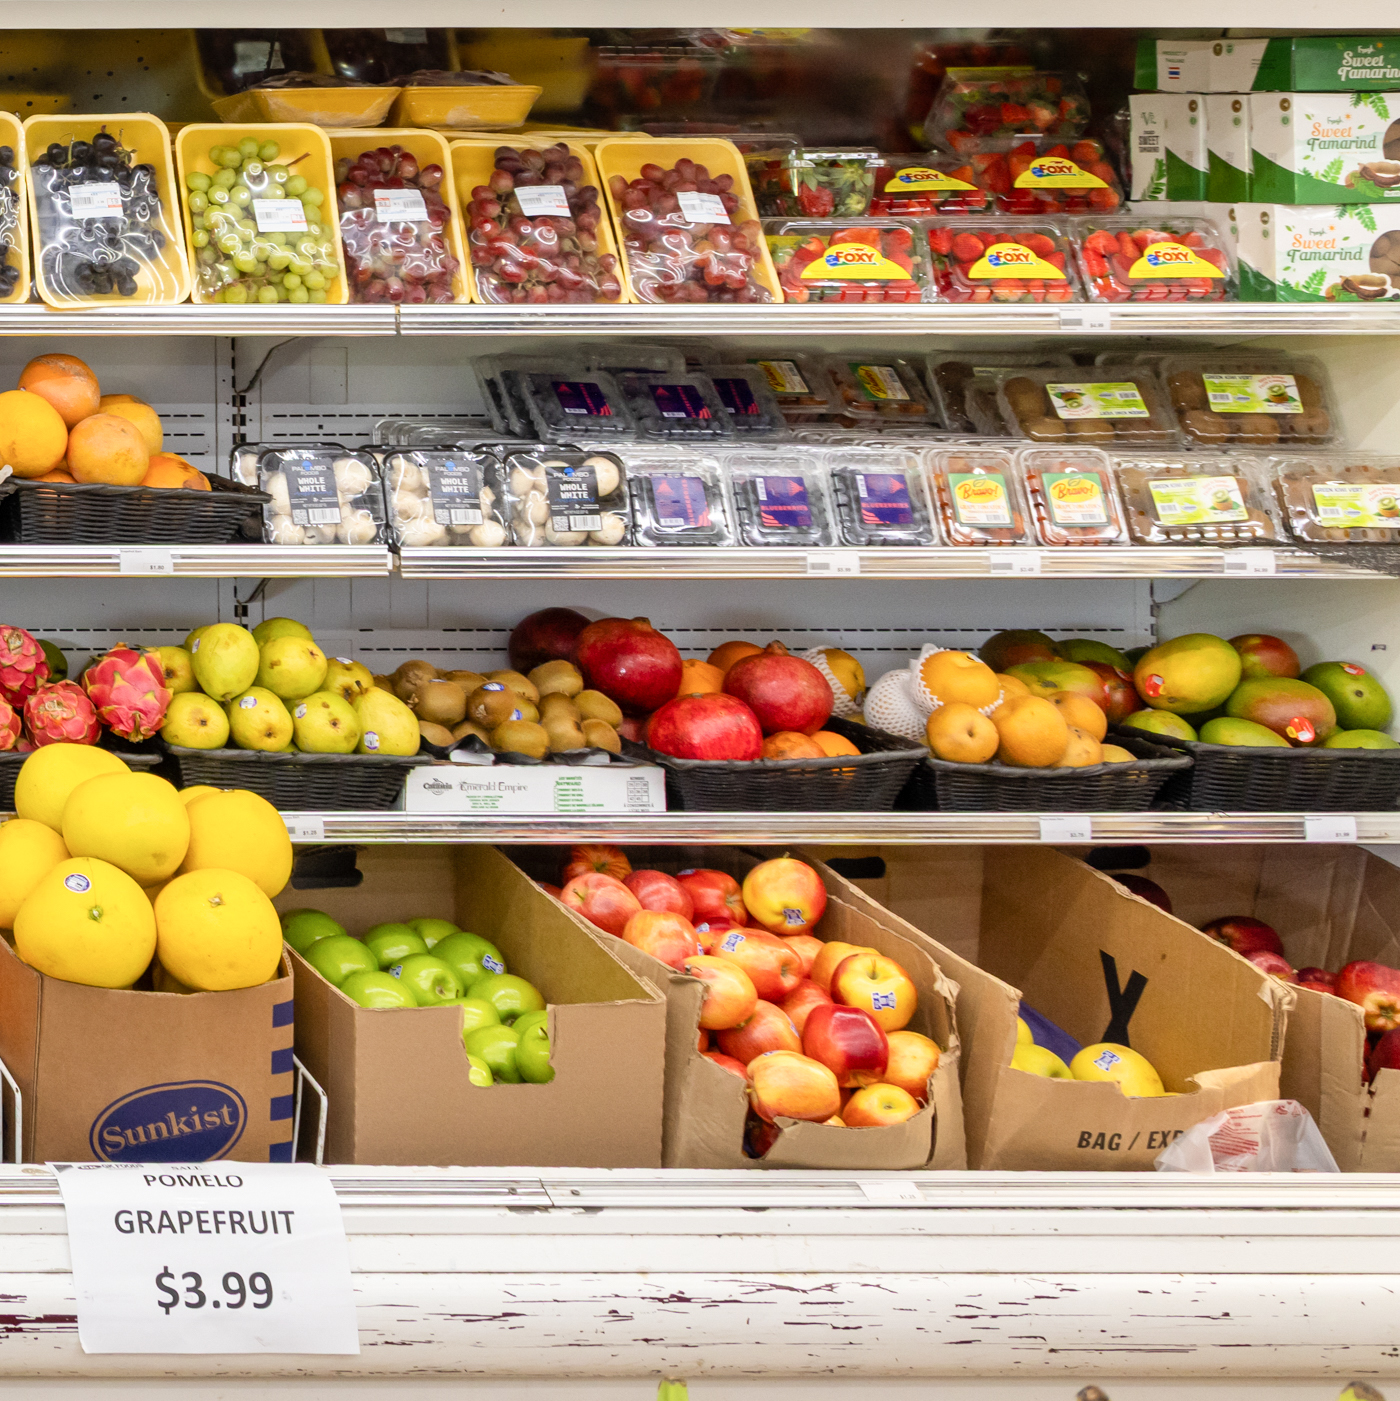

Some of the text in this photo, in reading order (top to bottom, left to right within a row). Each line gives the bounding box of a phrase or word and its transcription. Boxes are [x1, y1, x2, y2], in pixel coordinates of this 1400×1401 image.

[1342, 51, 1384, 66] Sweet
[1311, 122, 1352, 138] Sweet
[1307, 137, 1377, 151] Tamarind
[1039, 162, 1073, 176] FOXY
[1292, 234, 1336, 249] Sweet
[835, 250, 875, 264] FOXY
[1156, 249, 1190, 264] FOXY
[1287, 248, 1362, 262] Tamarind
[440, 478, 468, 486] WHOLE
[1054, 483, 1094, 498] Bravo!
[460, 782, 528, 793] Emerald Empire
[103, 1104, 236, 1152] Sunkist
[1077, 1130, 1122, 1151] BAG
[143, 1174, 243, 1187] POMELO
[114, 1210, 294, 1234] GRAPEFRUIT
[156, 1266, 273, 1315] $3.99
